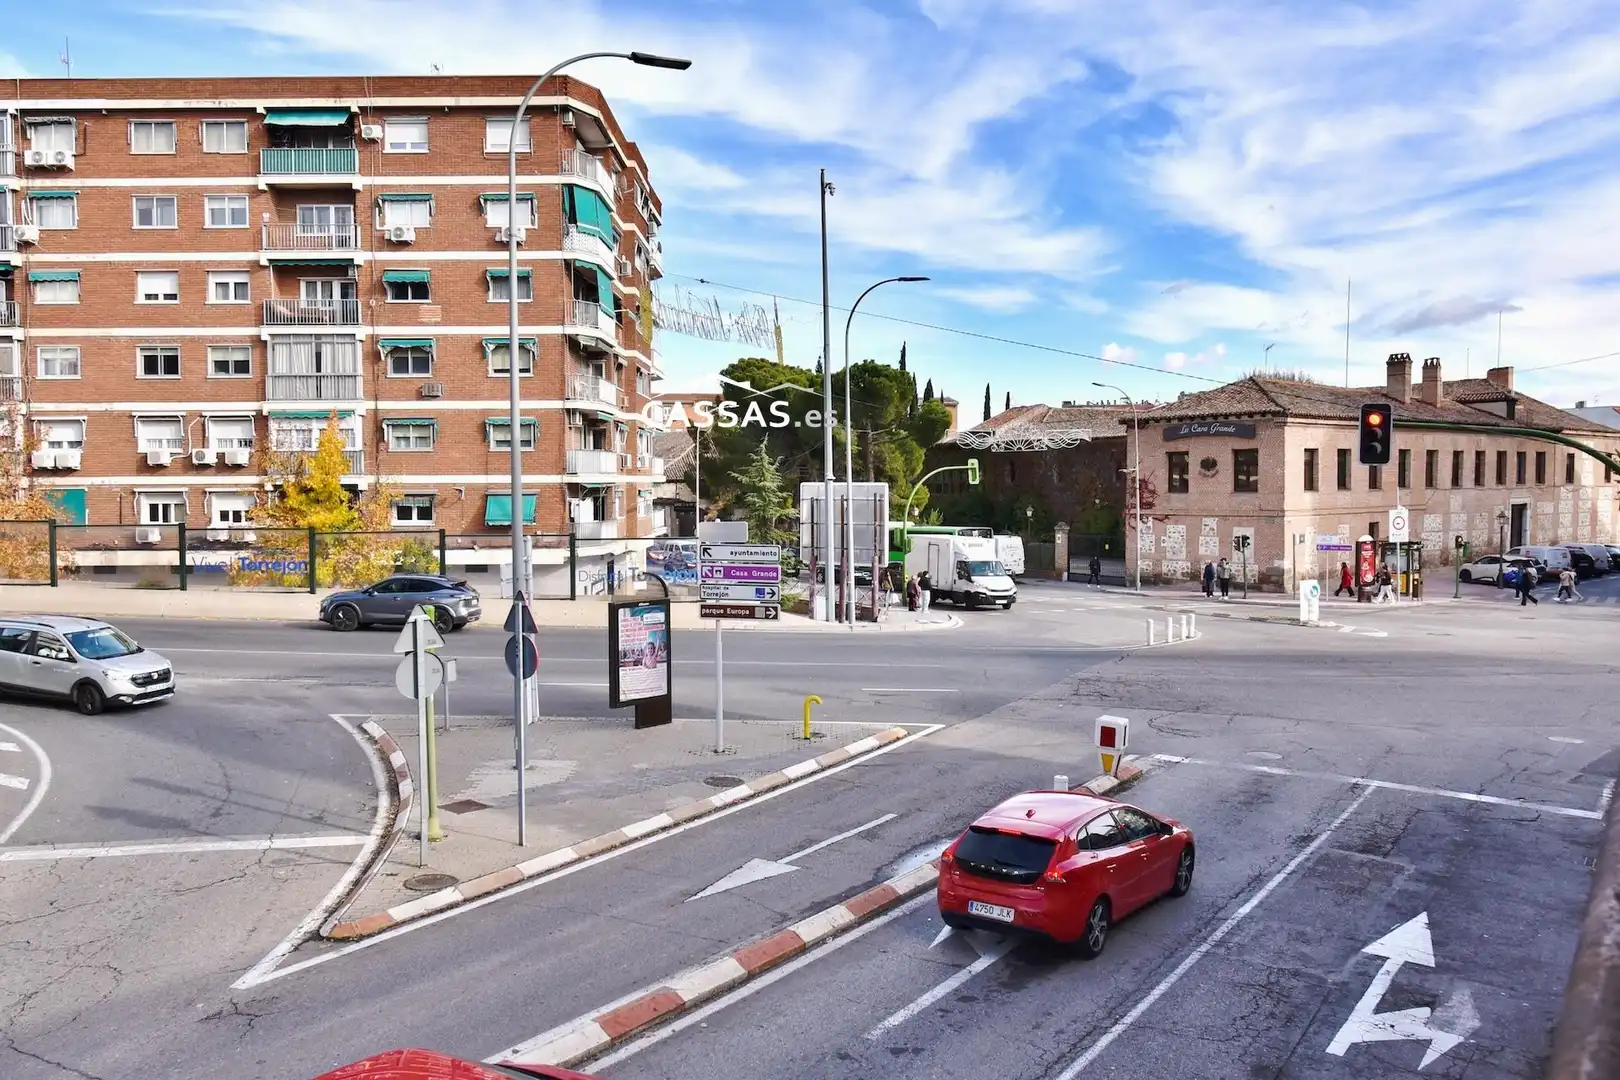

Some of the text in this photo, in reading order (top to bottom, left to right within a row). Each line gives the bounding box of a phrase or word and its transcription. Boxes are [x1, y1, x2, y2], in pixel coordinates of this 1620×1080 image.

[1180, 425, 1189, 434] La
[1210, 422, 1236, 434] Grande
[726, 607, 750, 616] Europa
[974, 903, 994, 914] 4750
